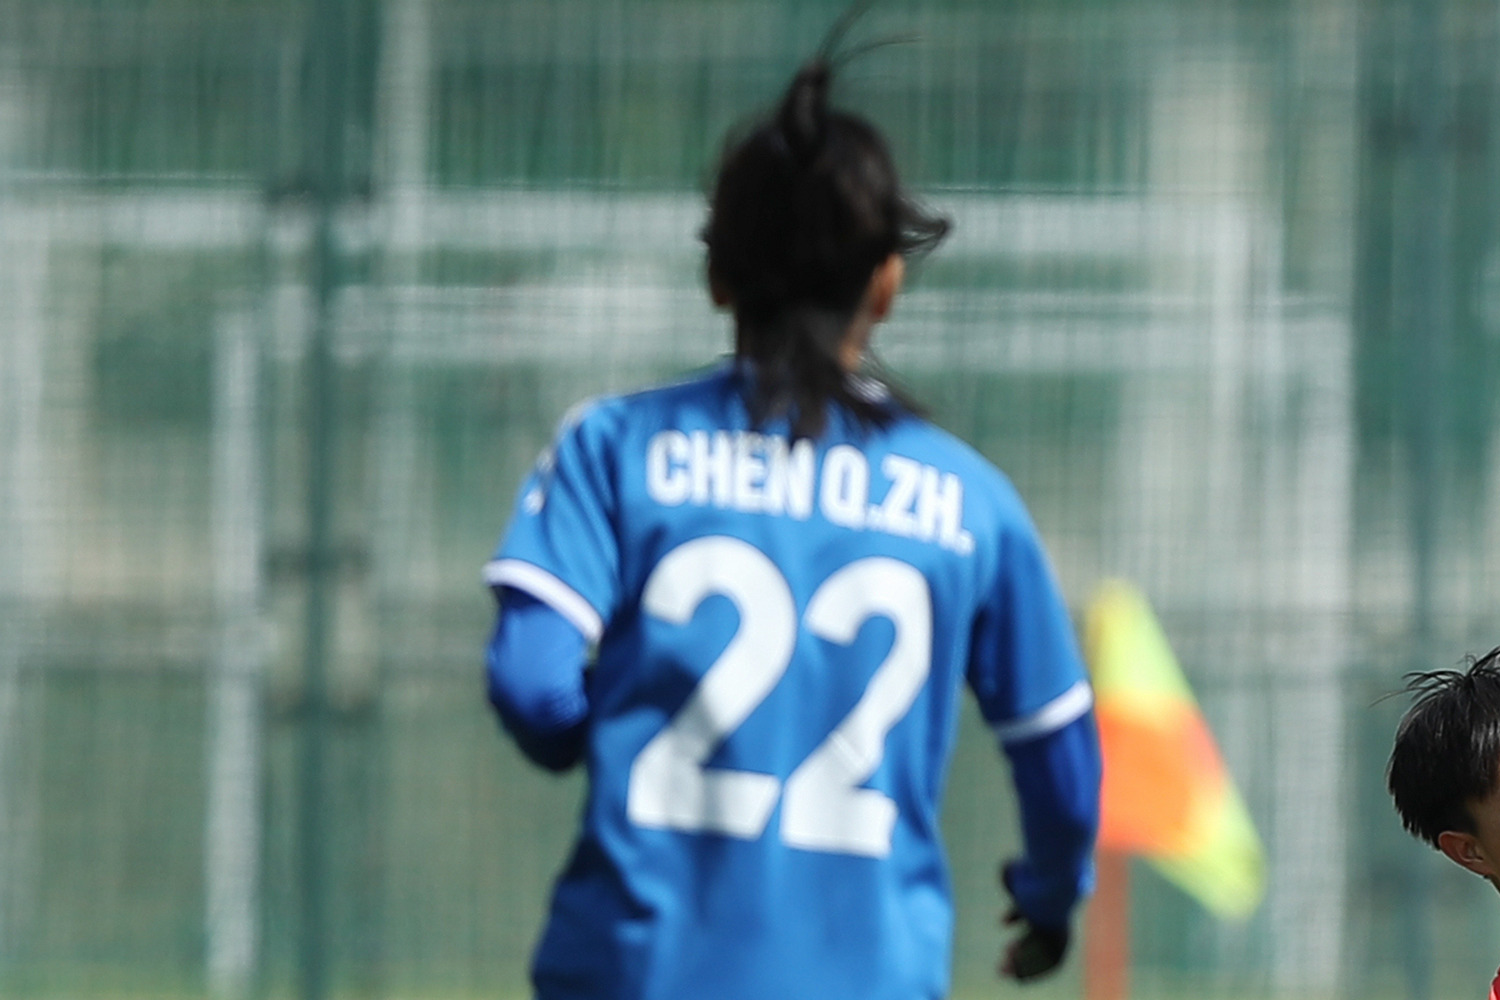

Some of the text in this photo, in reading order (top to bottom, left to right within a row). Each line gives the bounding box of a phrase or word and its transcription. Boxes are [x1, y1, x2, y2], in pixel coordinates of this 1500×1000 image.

[646, 429, 976, 557] CHEN Q.ZH.
[626, 534, 934, 861] 22
